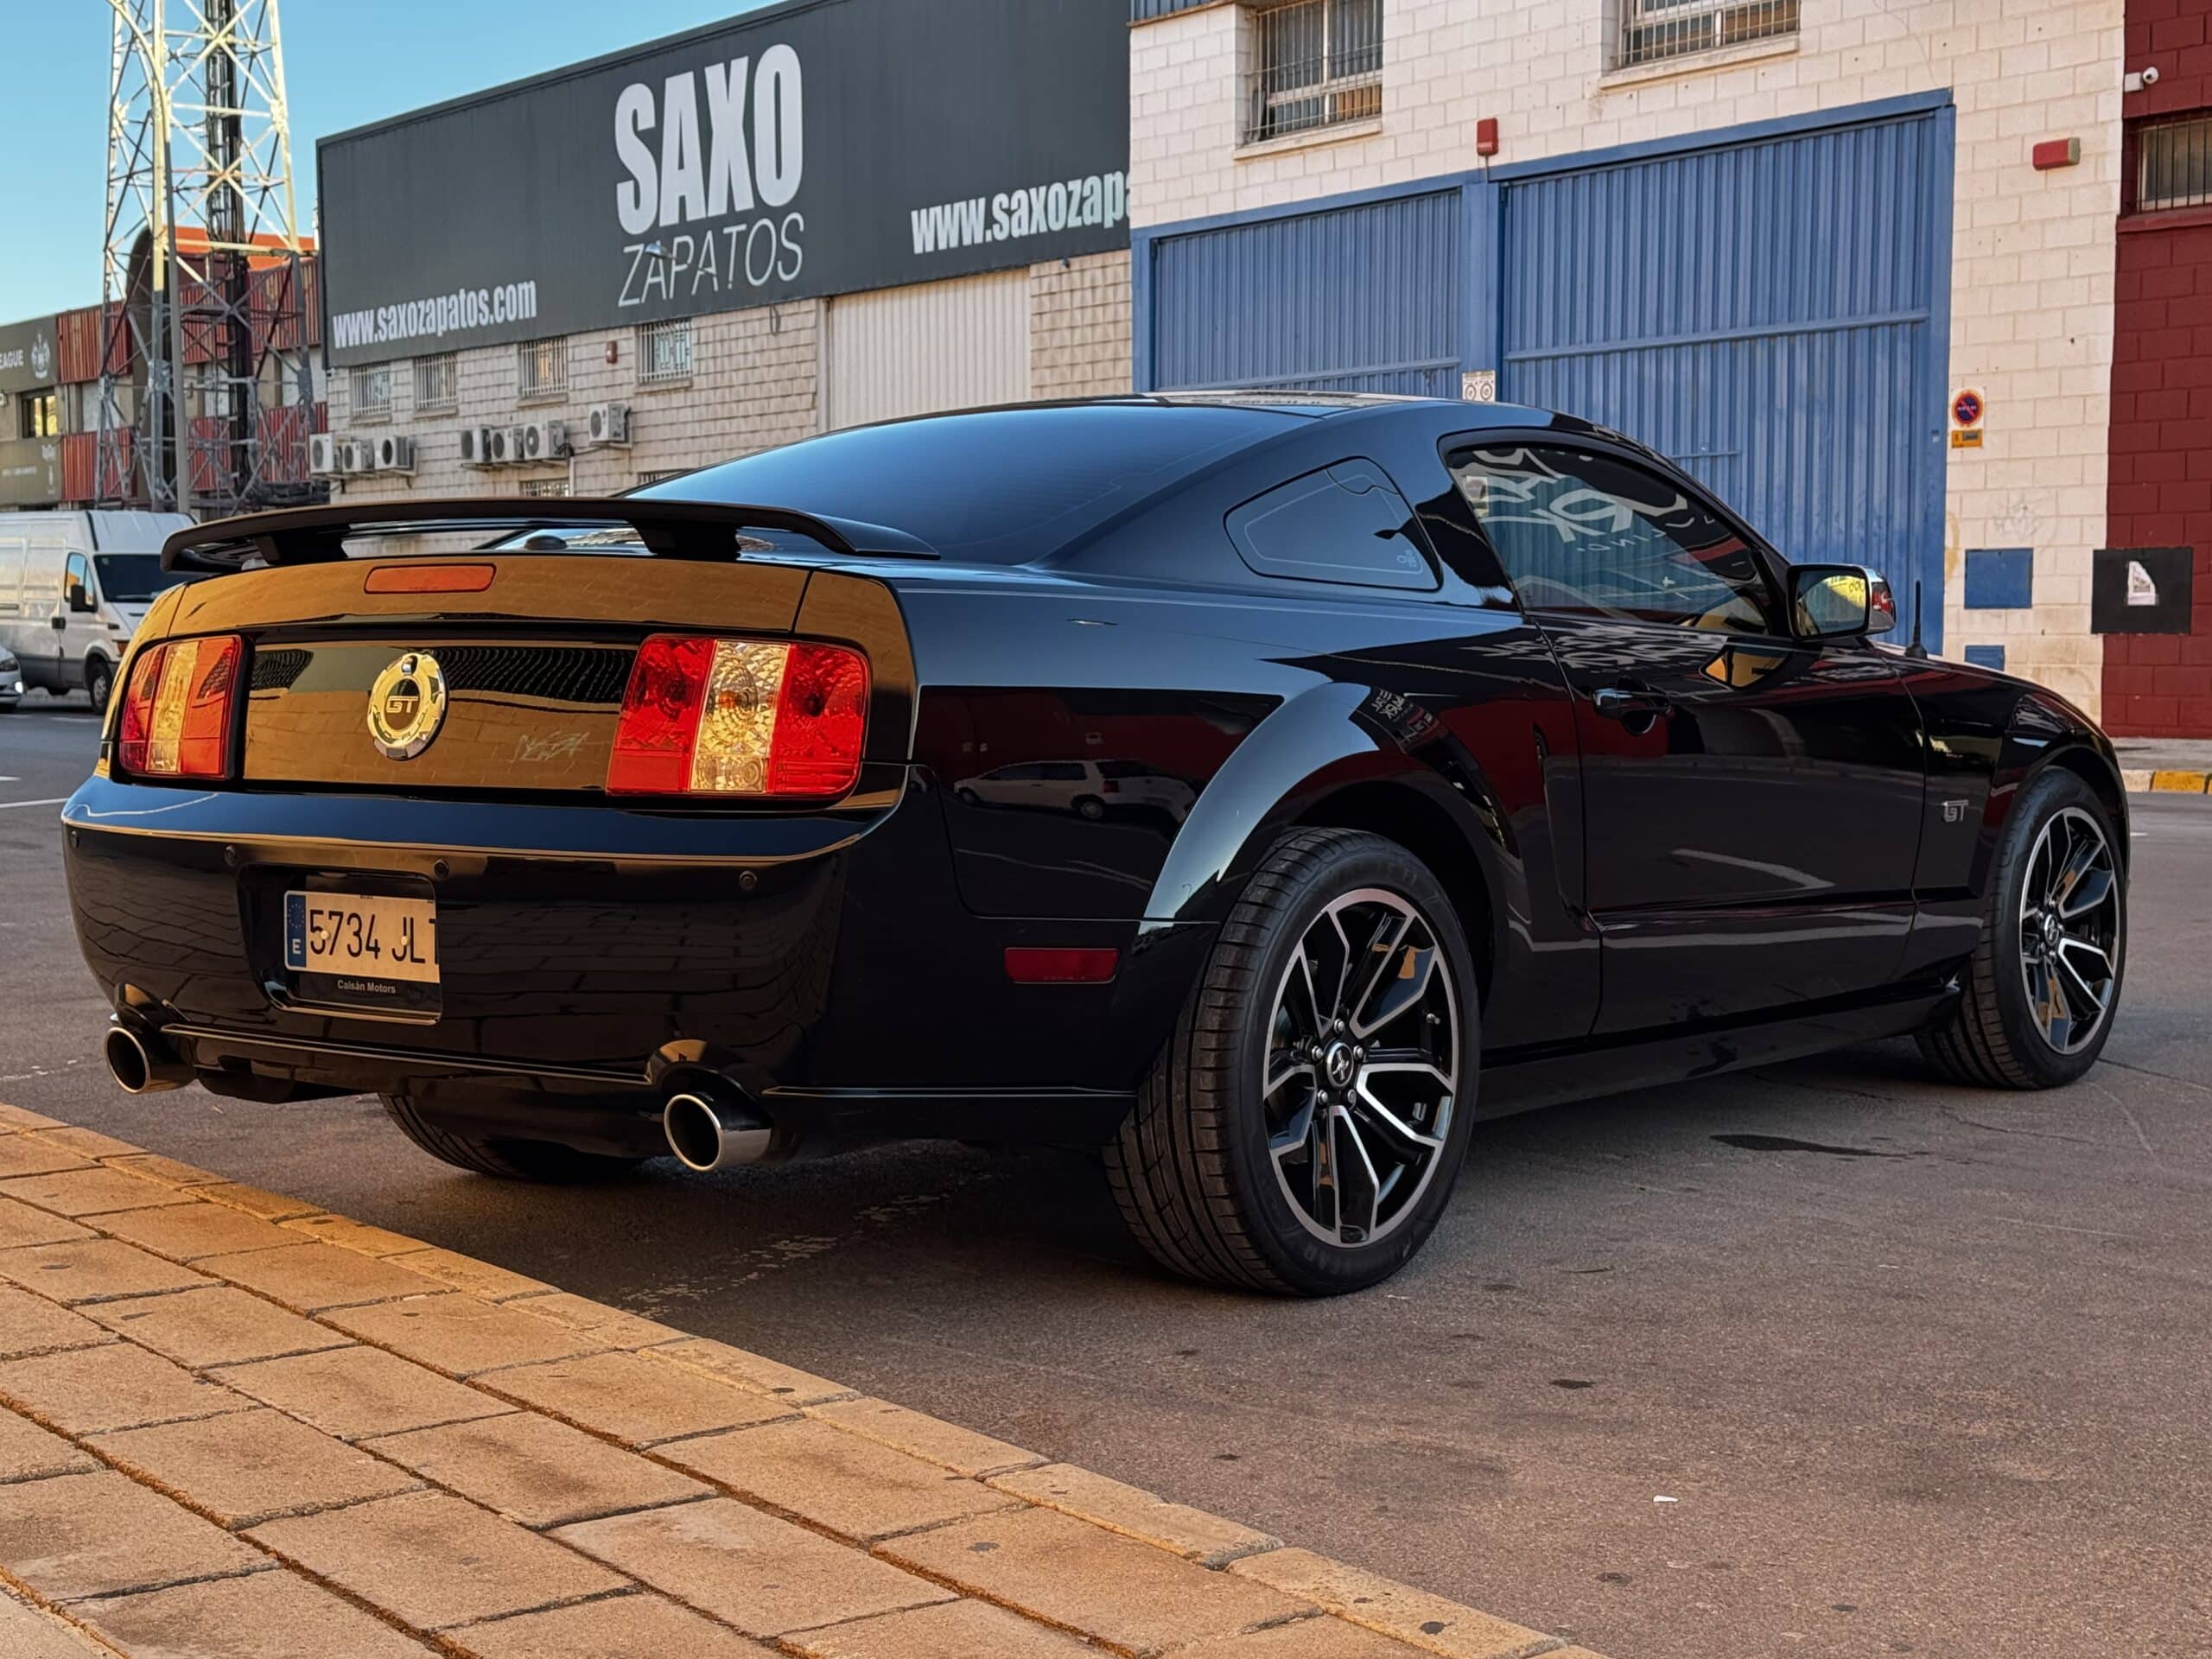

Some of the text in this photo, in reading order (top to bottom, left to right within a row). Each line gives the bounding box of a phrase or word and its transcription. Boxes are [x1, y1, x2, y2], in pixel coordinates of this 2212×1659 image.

[615, 44, 804, 235] SAXO
[911, 171, 1130, 255] www.saxozap
[618, 213, 804, 307] ZAPATOS
[333, 280, 537, 348] www.saxozapatos.com
[386, 696, 419, 713] GT
[1942, 799, 1969, 822] GT
[292, 939, 301, 954] E
[310, 909, 380, 959] 5734
[367, 982, 396, 994] Motors
